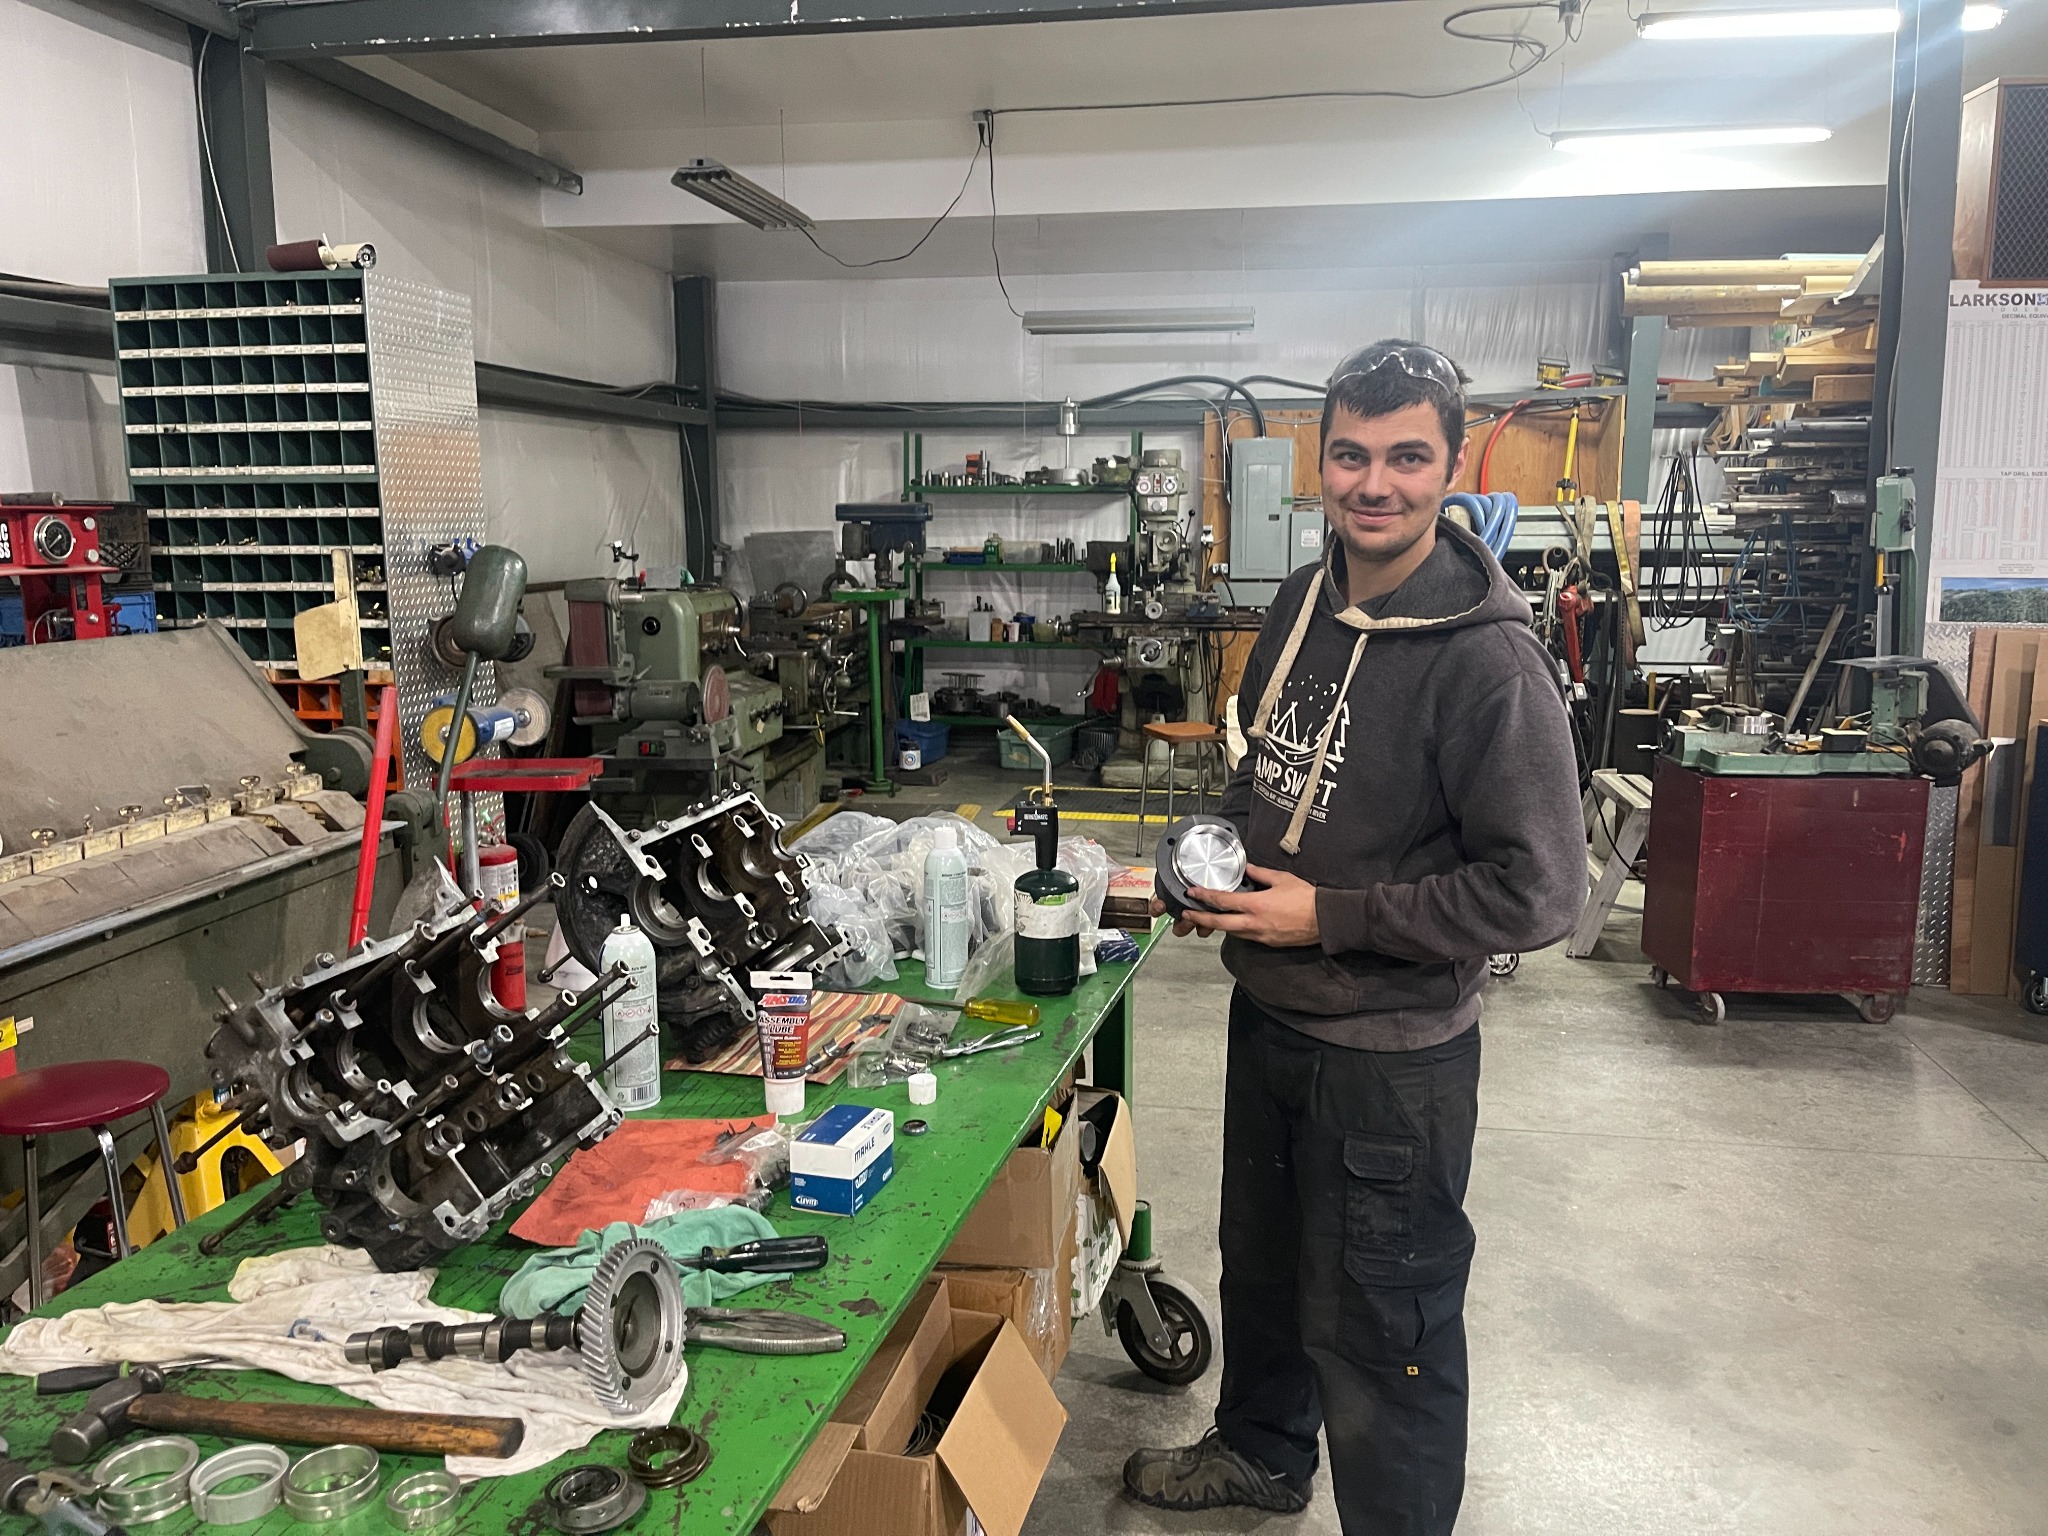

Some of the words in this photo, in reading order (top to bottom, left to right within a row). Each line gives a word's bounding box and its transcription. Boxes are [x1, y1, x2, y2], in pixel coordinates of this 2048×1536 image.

[1950, 293, 2036, 307] LARKSON
[1255, 753, 1282, 785] AMP
[1281, 766, 1337, 806] SWT
[758, 993, 807, 1007] AMSOIL
[758, 1015, 807, 1026] ASSEMBLY
[768, 1025, 795, 1035] LUBE
[854, 1136, 875, 1164] MAHLE
